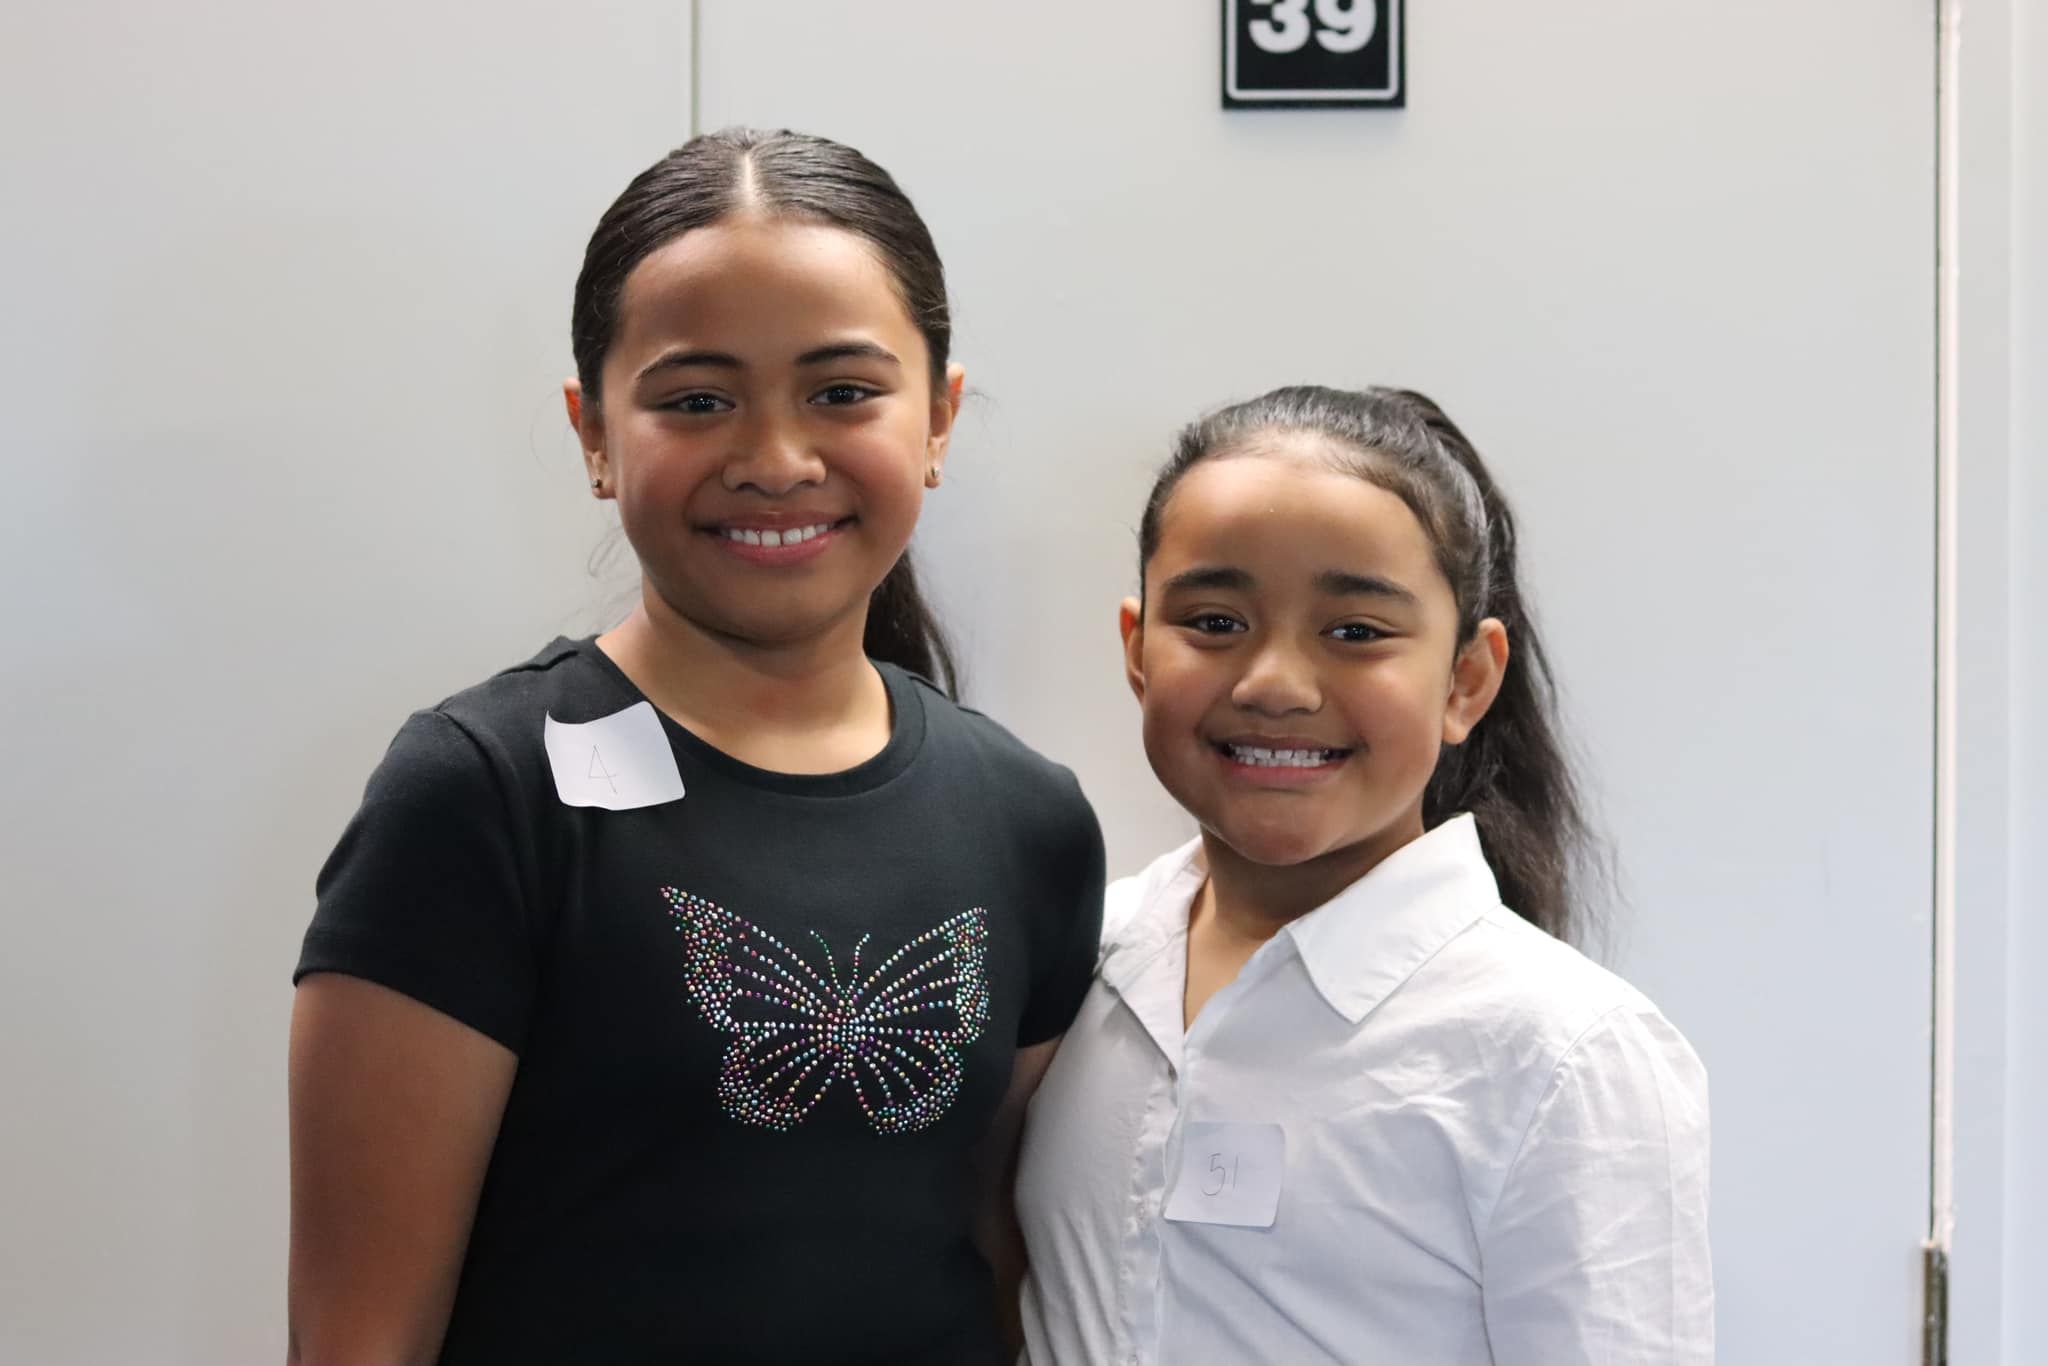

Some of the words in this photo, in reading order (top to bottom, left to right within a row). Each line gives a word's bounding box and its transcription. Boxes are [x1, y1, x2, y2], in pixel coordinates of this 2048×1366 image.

[1248, 0, 1377, 53] 39
[587, 744, 618, 795] 4
[1201, 1152, 1239, 1197] 51
